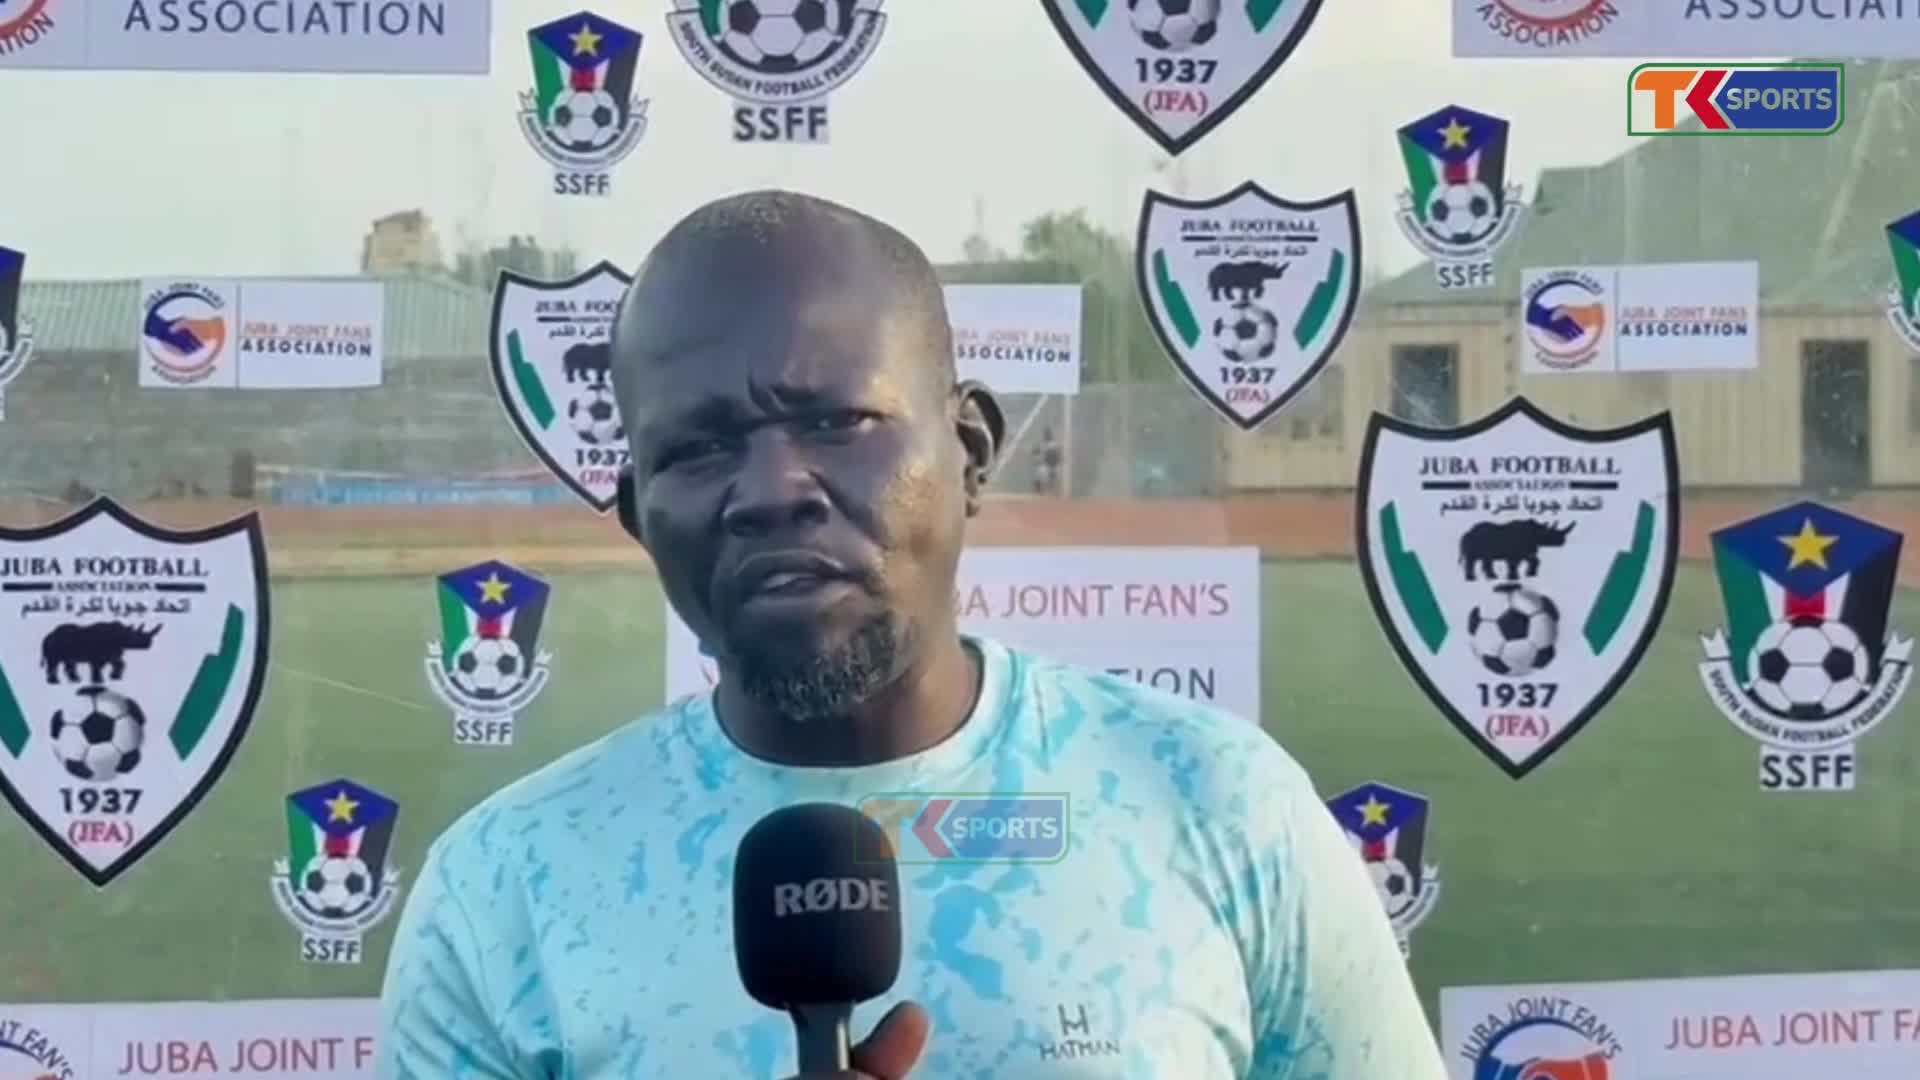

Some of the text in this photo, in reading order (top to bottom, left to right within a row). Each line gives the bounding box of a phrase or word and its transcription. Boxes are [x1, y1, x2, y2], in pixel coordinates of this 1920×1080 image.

[124, 0, 444, 35] ASSOCIATION
[1476, 1, 1619, 48] ASSOCIATION
[1135, 58, 1218, 83] 1937
[754, 75, 824, 95] FOOTBALL
[1143, 88, 1209, 117] (JFA)
[733, 105, 827, 142] SSFF
[554, 173, 609, 195] SSFF
[1230, 220, 1320, 232] FOOTBALL
[1439, 262, 1493, 288] SSFF
[1621, 322, 1748, 336] ASSOCIATION
[242, 339, 372, 357] ASSOCIATION
[958, 345, 1071, 362] SSOCIATION
[1220, 367, 1276, 384] 1937
[575, 449, 630, 466] 1937
[1419, 456, 1622, 475] JUBA FOOTBALL
[0, 556, 210, 577] JUBA FOOTBALL
[1001, 584, 1113, 618] JOINT
[1124, 583, 1230, 618] FAN'S
[1477, 683, 1558, 708] 1937
[456, 719, 512, 742] SSFF
[1485, 715, 1550, 741] (JFA)
[1762, 754, 1853, 788] SSFF
[59, 788, 144, 814] 1937
[68, 820, 134, 846] (JFA)
[774, 877, 889, 916] RØDE
[303, 937, 359, 961] SSFF
[1460, 1013, 1504, 1064] JUBA
[1507, 995, 1572, 1022] JOINT
[1664, 1013, 1762, 1050] JUBA
[1772, 1010, 1884, 1047] JOINT
[118, 1041, 218, 1075] JUBA
[229, 1037, 344, 1073] JOINT
